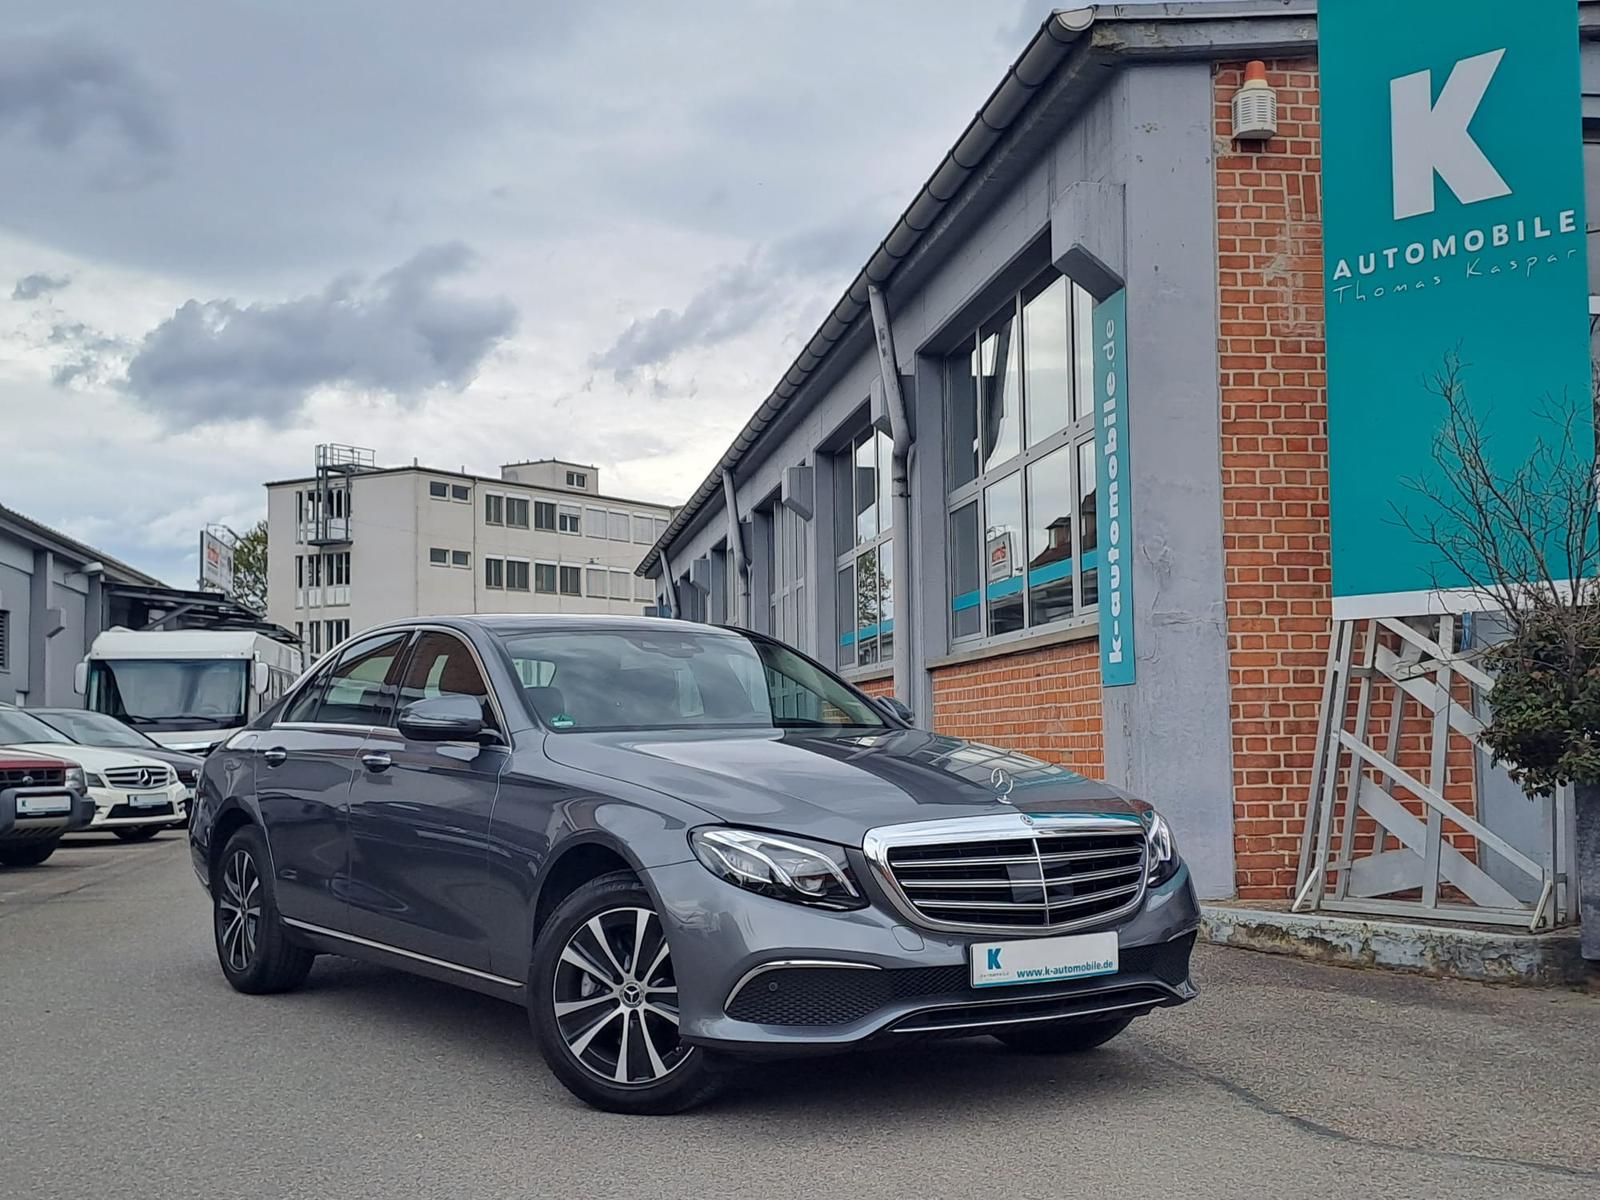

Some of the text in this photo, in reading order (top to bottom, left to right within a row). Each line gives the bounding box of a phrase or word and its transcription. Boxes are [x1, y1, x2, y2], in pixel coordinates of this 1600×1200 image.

[1390, 48, 1513, 221] K
[1332, 249, 1577, 305] Thomas Kaspar
[1333, 209, 1577, 281] AUTOMOBILE
[1103, 319, 1123, 663] k-automobile.de
[987, 947, 1002, 970] K
[1016, 960, 1113, 978] www.k-automobile.de
